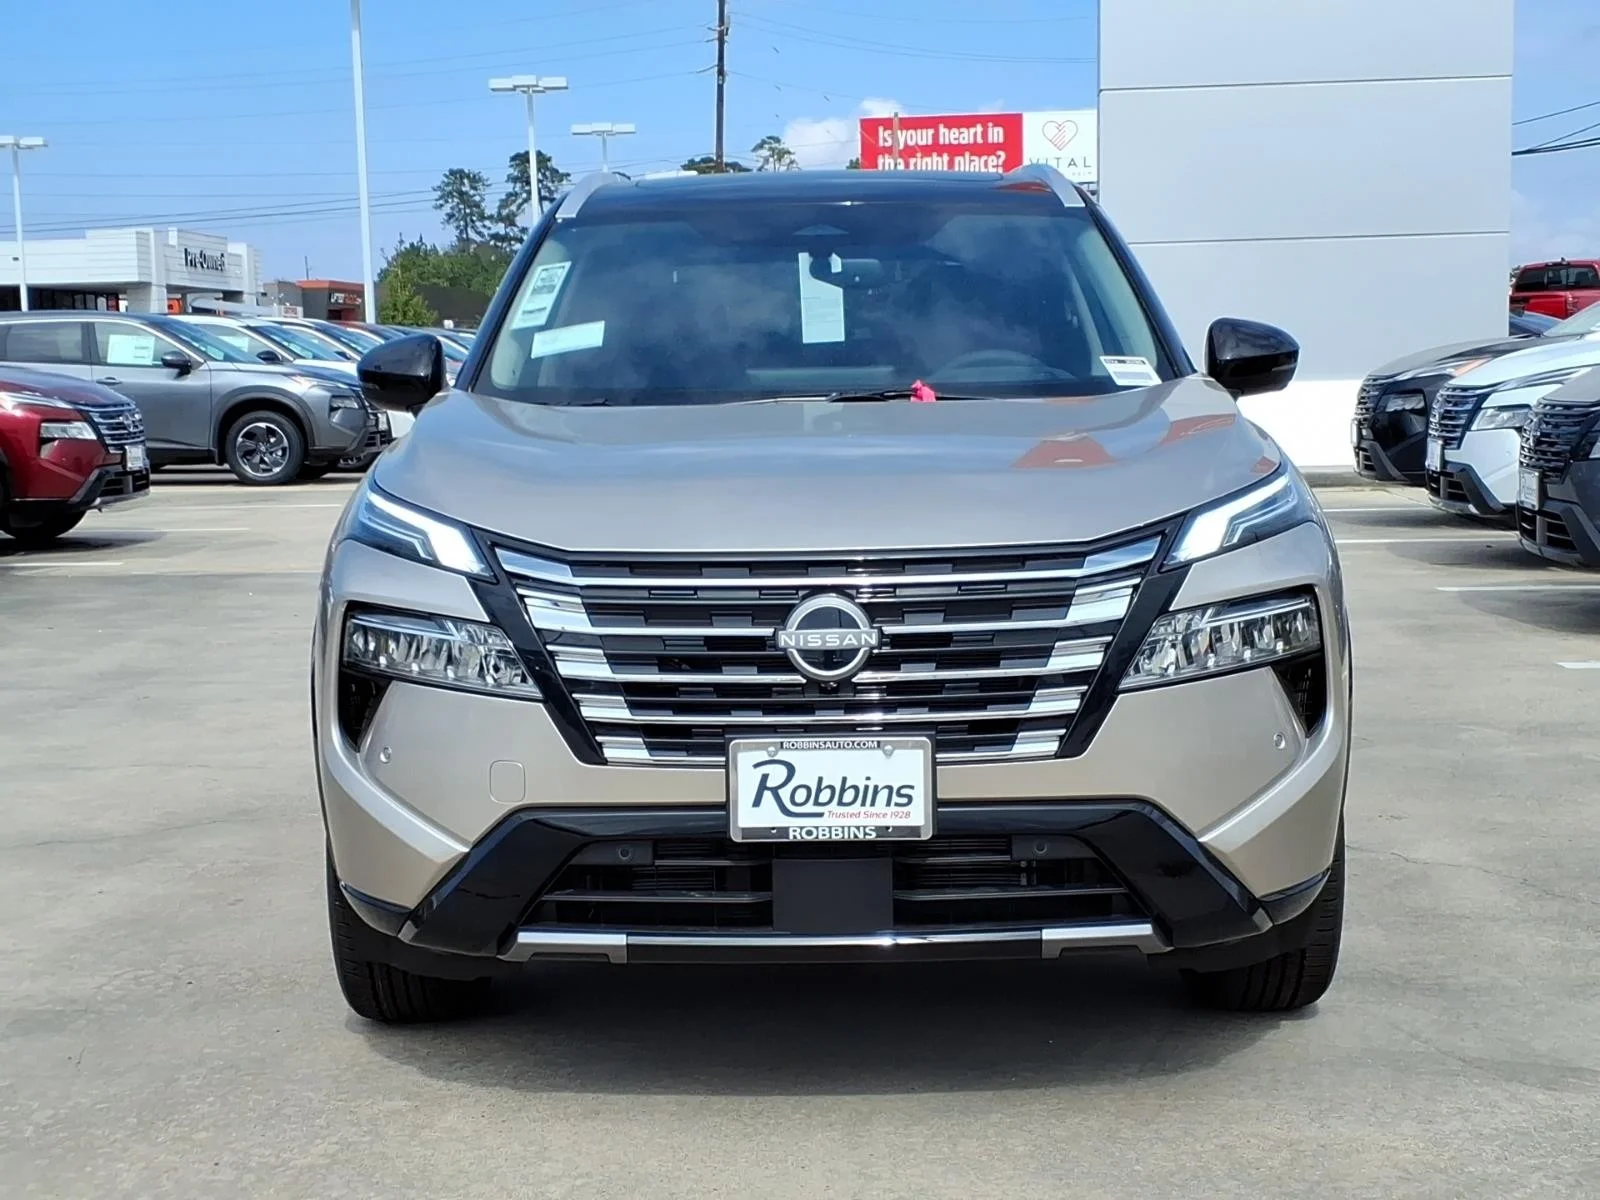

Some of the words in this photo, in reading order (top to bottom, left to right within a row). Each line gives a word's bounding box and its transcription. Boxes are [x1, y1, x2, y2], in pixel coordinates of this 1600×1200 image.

[878, 126, 893, 147] Is
[897, 128, 934, 150] your
[938, 123, 983, 145] heart
[987, 122, 1004, 144] in
[780, 633, 876, 647] NISSAN
[782, 740, 878, 750] ROBBINSAUTO.COM
[751, 758, 915, 818] Robbins
[826, 810, 862, 819] Trusted
[863, 810, 888, 819] Since
[890, 810, 911, 819] 1928
[789, 826, 877, 840] ROBBINS
